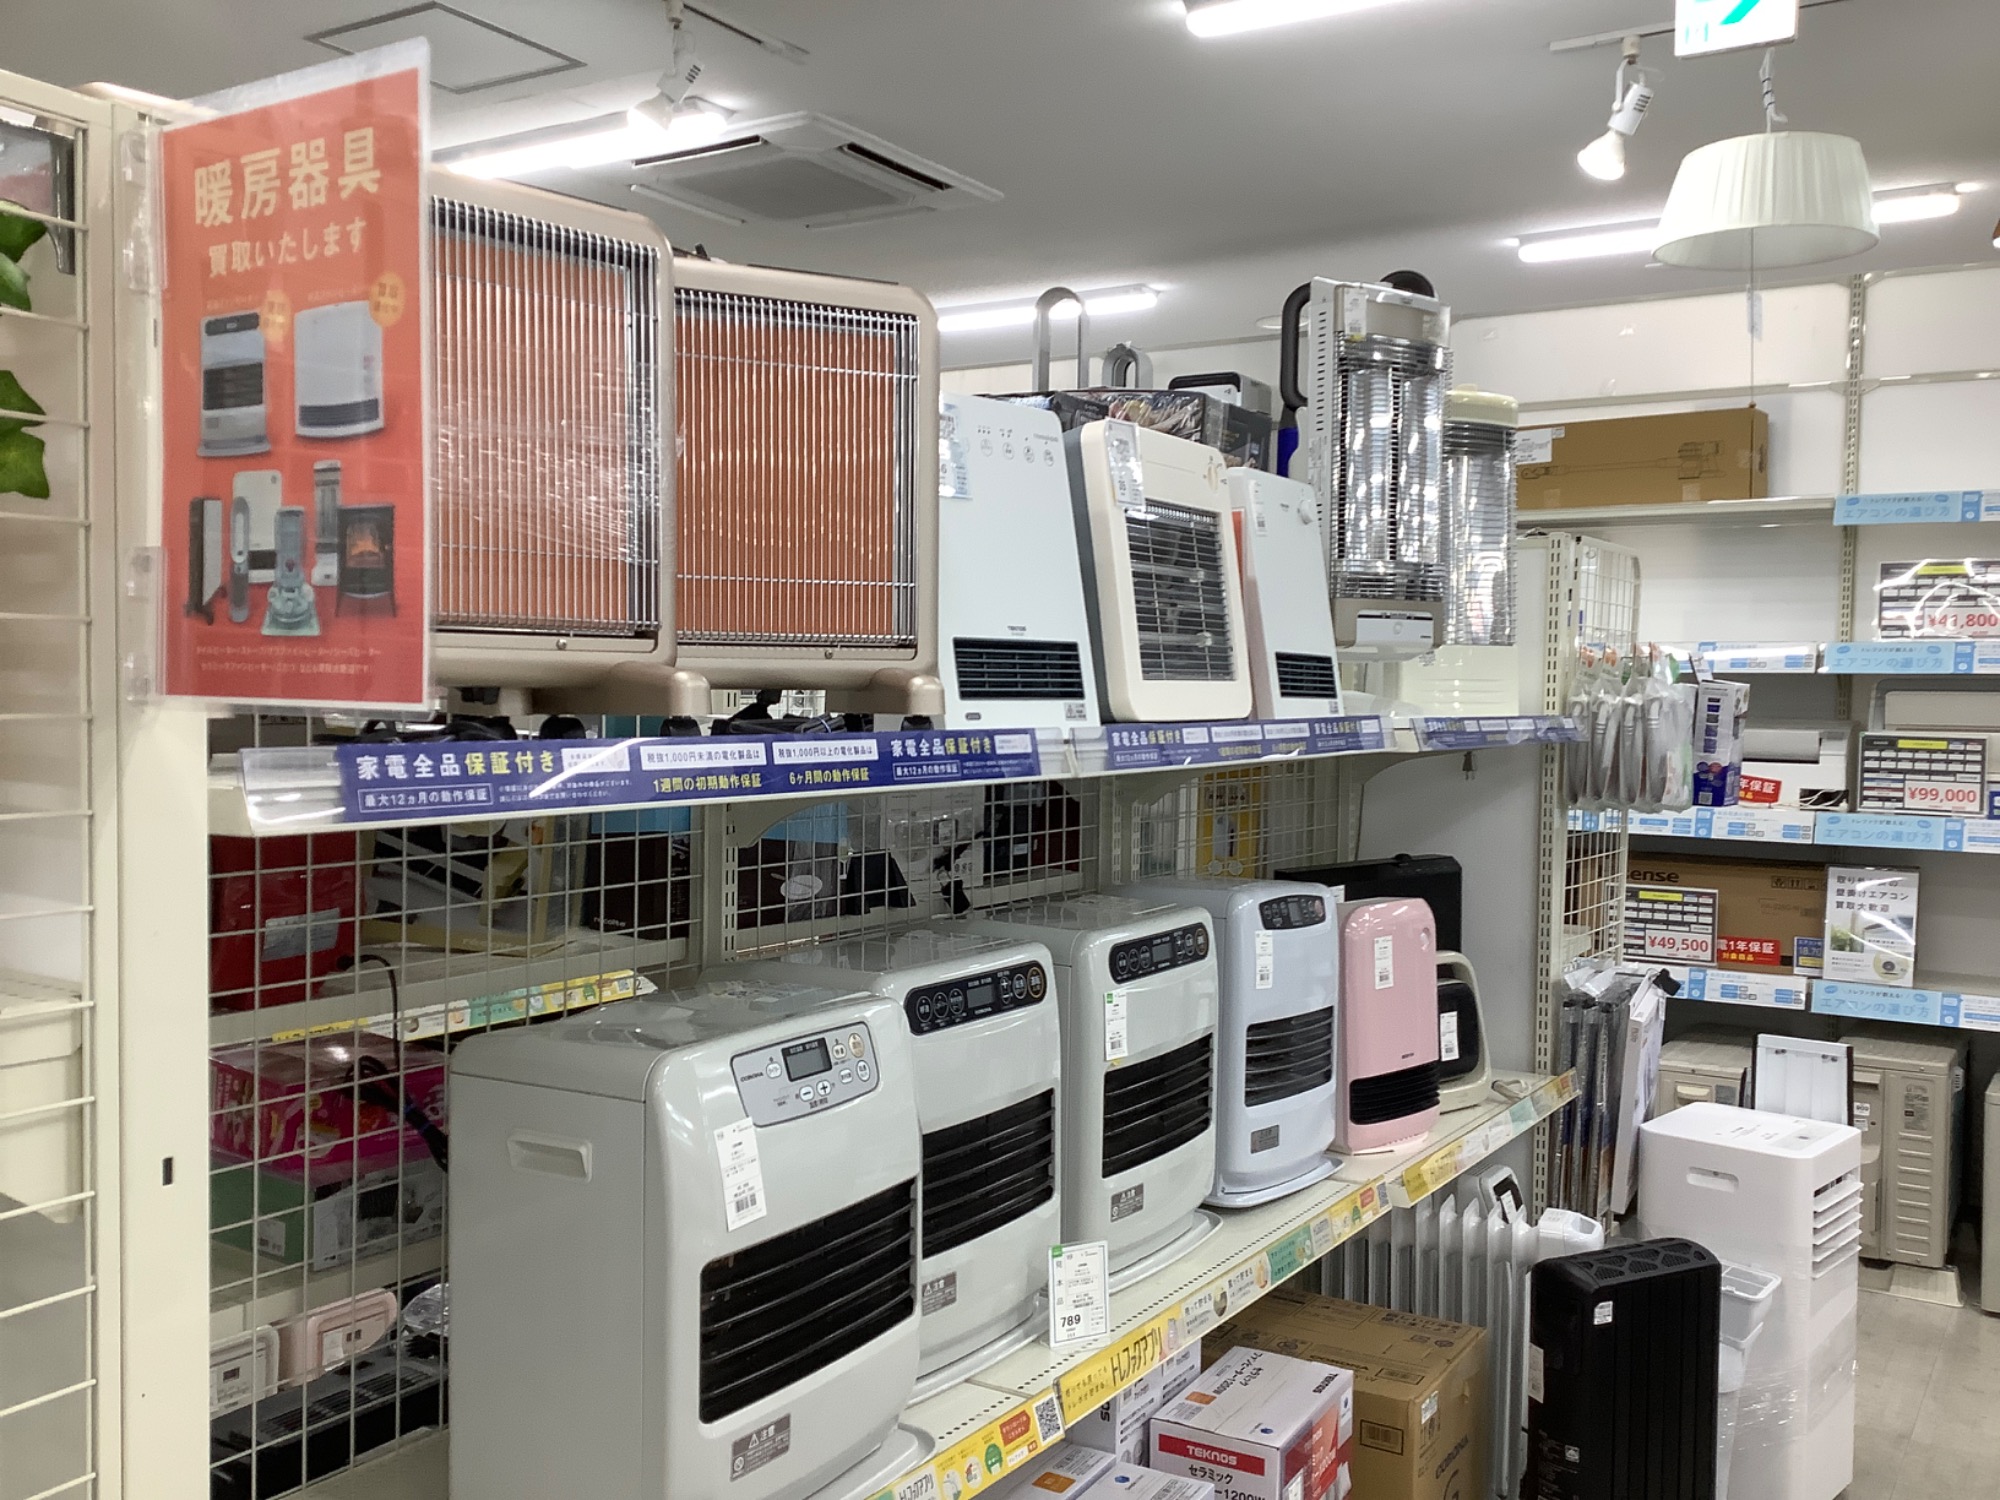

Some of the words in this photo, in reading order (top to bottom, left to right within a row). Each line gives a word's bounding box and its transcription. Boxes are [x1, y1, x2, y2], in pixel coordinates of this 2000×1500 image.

[194, 127, 382, 228] 暖房器具
[208, 217, 368, 279] 買取いたします
[1842, 505, 1951, 519] エアコンの選び方
[1927, 613, 1998, 630] ¥41,800
[1833, 656, 1944, 669] エアコンの選び方
[647, 749, 760, 764] 税抜1,000円未満の電化製品は
[778, 746, 873, 759] 税抜1,000円以上の電化製品は
[890, 737, 992, 757] 家電全品保証付き
[356, 750, 554, 780] 家電全品保証付き
[653, 772, 763, 794] 1週間の初期動作保証
[1907, 786, 1978, 804] ¥99,000
[1824, 828, 1934, 844] エアコンの選び方
[1648, 935, 1710, 954] ¥49,500
[1820, 998, 1930, 1019] エアコンの選び方
[1060, 1314, 1082, 1328] 789
[1186, 1444, 1238, 1466] TEKNOS
[1188, 1464, 1234, 1485] セラミック
